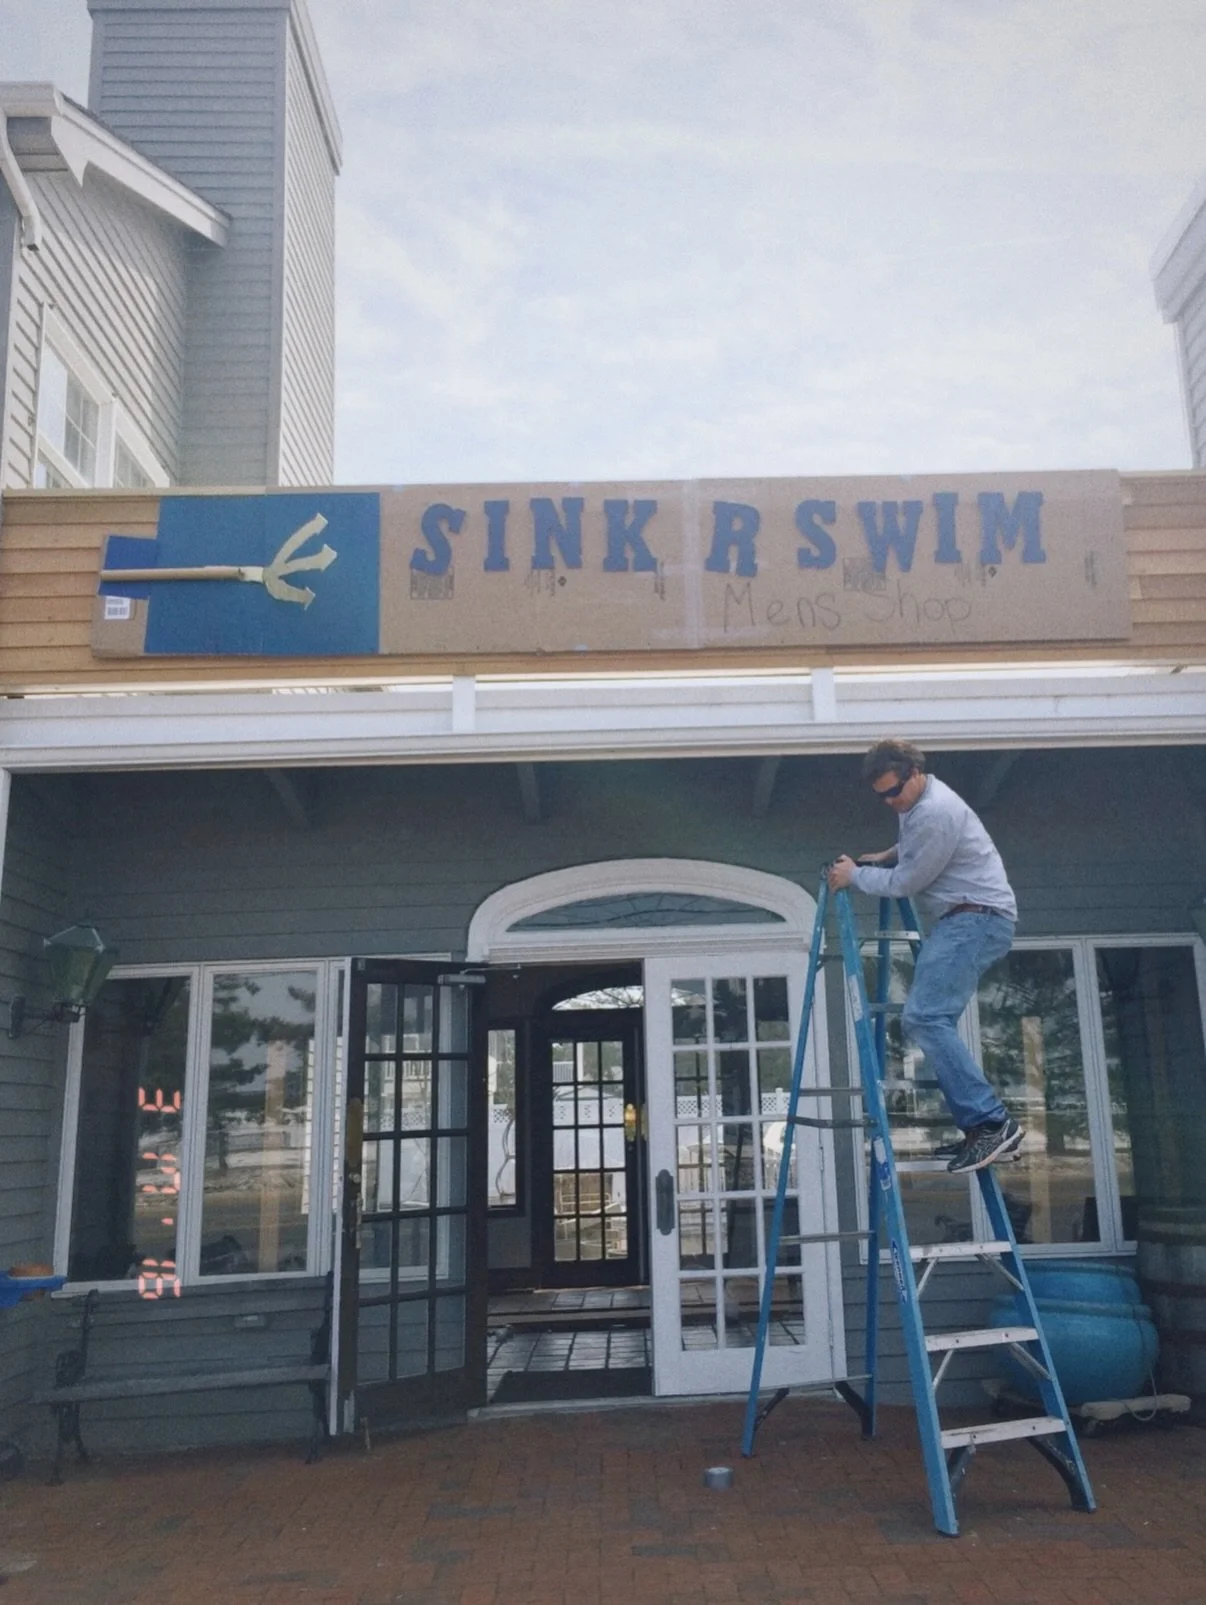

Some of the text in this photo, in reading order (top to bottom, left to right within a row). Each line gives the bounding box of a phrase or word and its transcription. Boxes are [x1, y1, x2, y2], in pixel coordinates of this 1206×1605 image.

[410, 497, 658, 576] SINK
[704, 500, 761, 577] R
[795, 491, 1047, 573] SWIM
[724, 582, 842, 633] Mens
